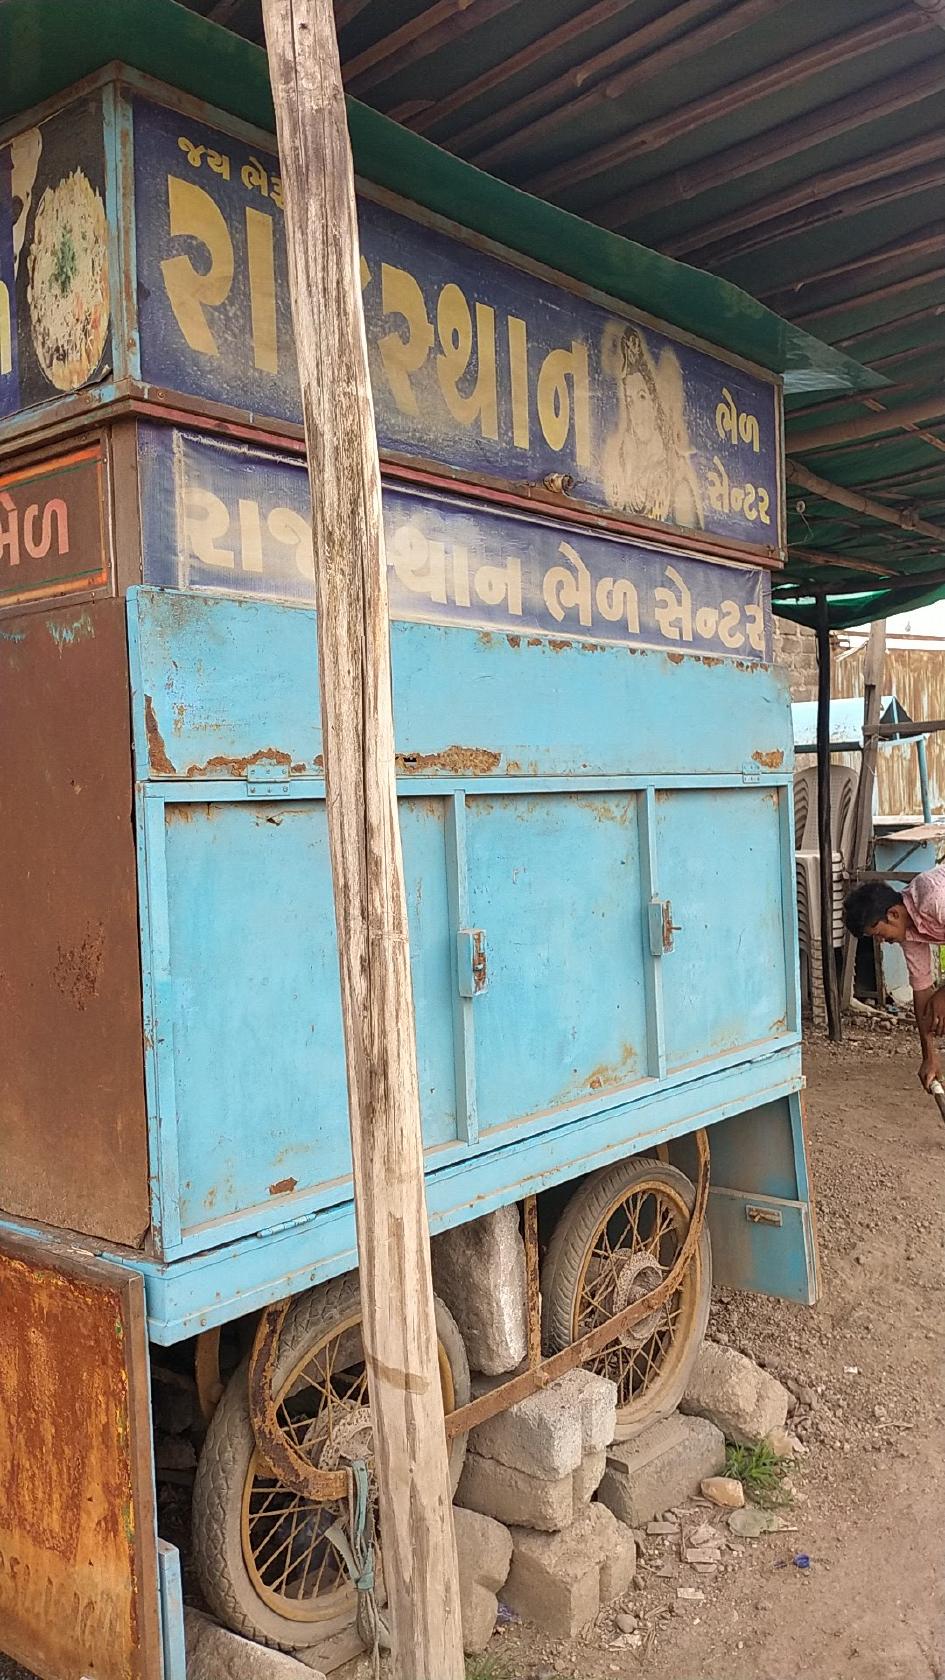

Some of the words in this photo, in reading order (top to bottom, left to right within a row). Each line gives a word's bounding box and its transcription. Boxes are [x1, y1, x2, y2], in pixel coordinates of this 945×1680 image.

[177, 136, 231, 181] જય
[715, 386, 760, 453] ભેળ
[705, 455, 771, 526] સેન્ટર
[542, 541, 640, 634] ભેળ
[655, 565, 766, 652] સેન્ટર
